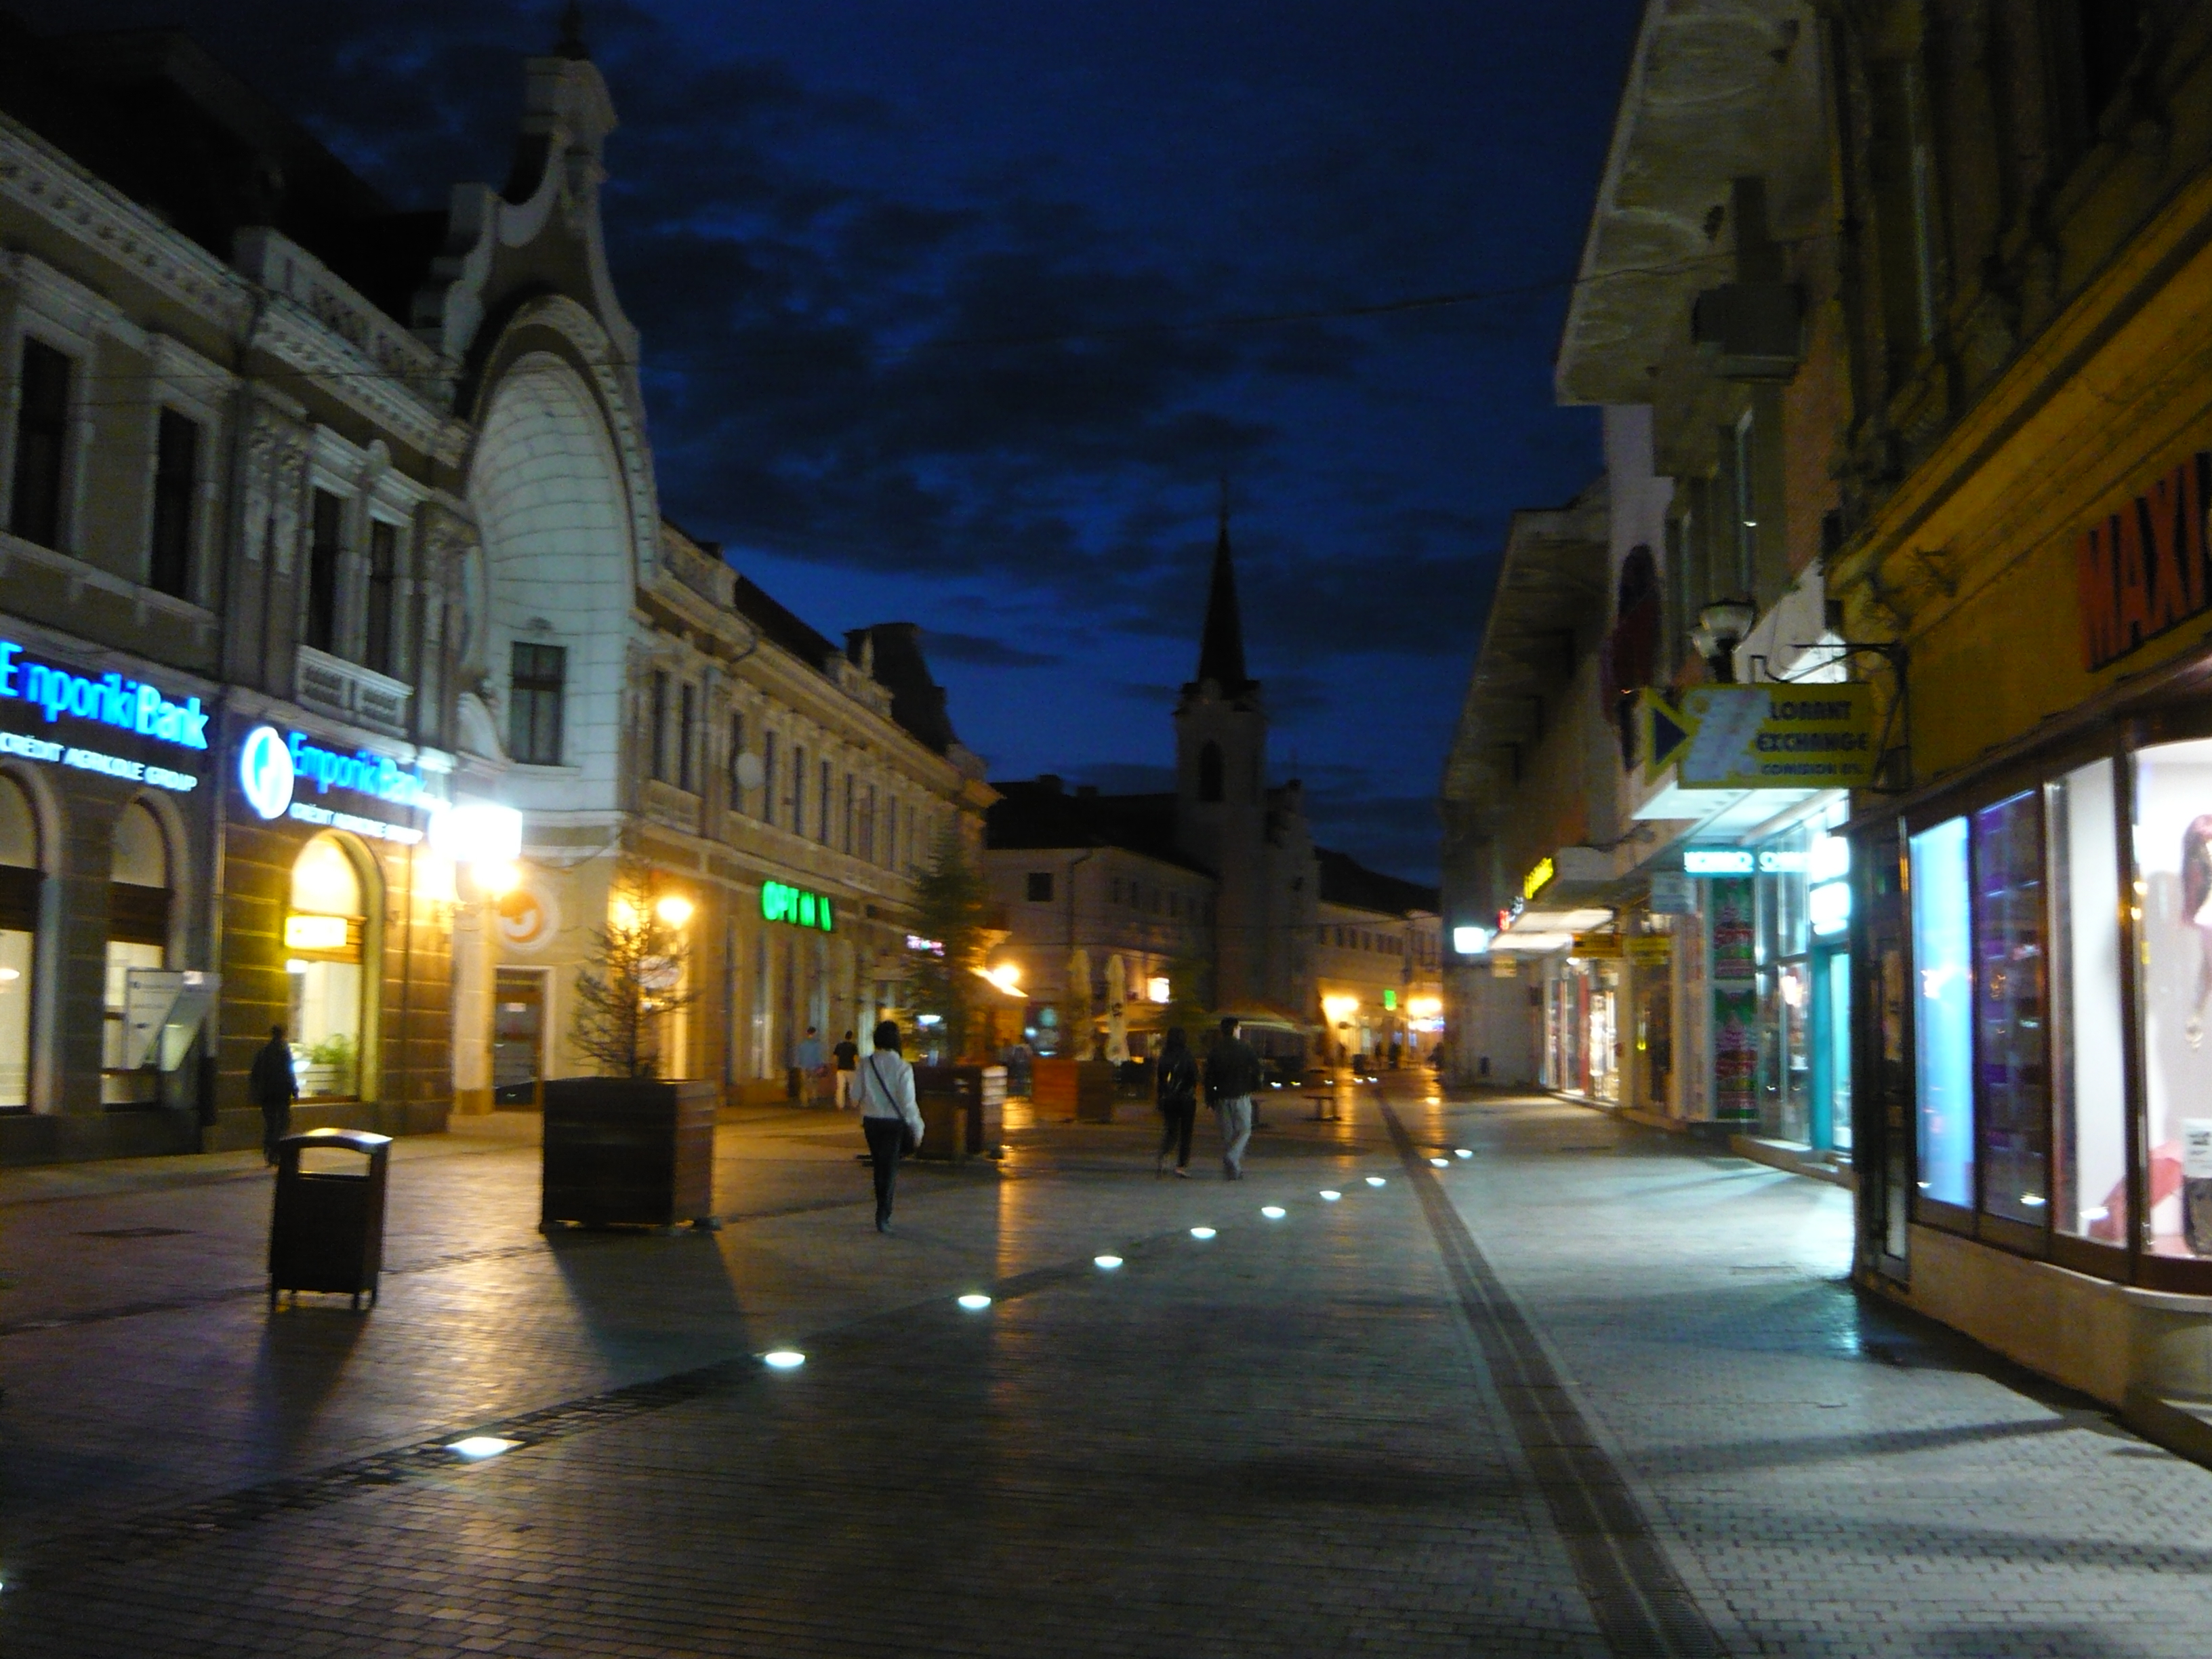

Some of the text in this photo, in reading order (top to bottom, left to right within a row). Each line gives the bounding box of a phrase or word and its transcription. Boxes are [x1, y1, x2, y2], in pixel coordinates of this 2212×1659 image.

[1757, 731, 1868, 752] EXCHANGE
[63, 747, 146, 781] AGRICOLE
[144, 766, 198, 792] GROUP
